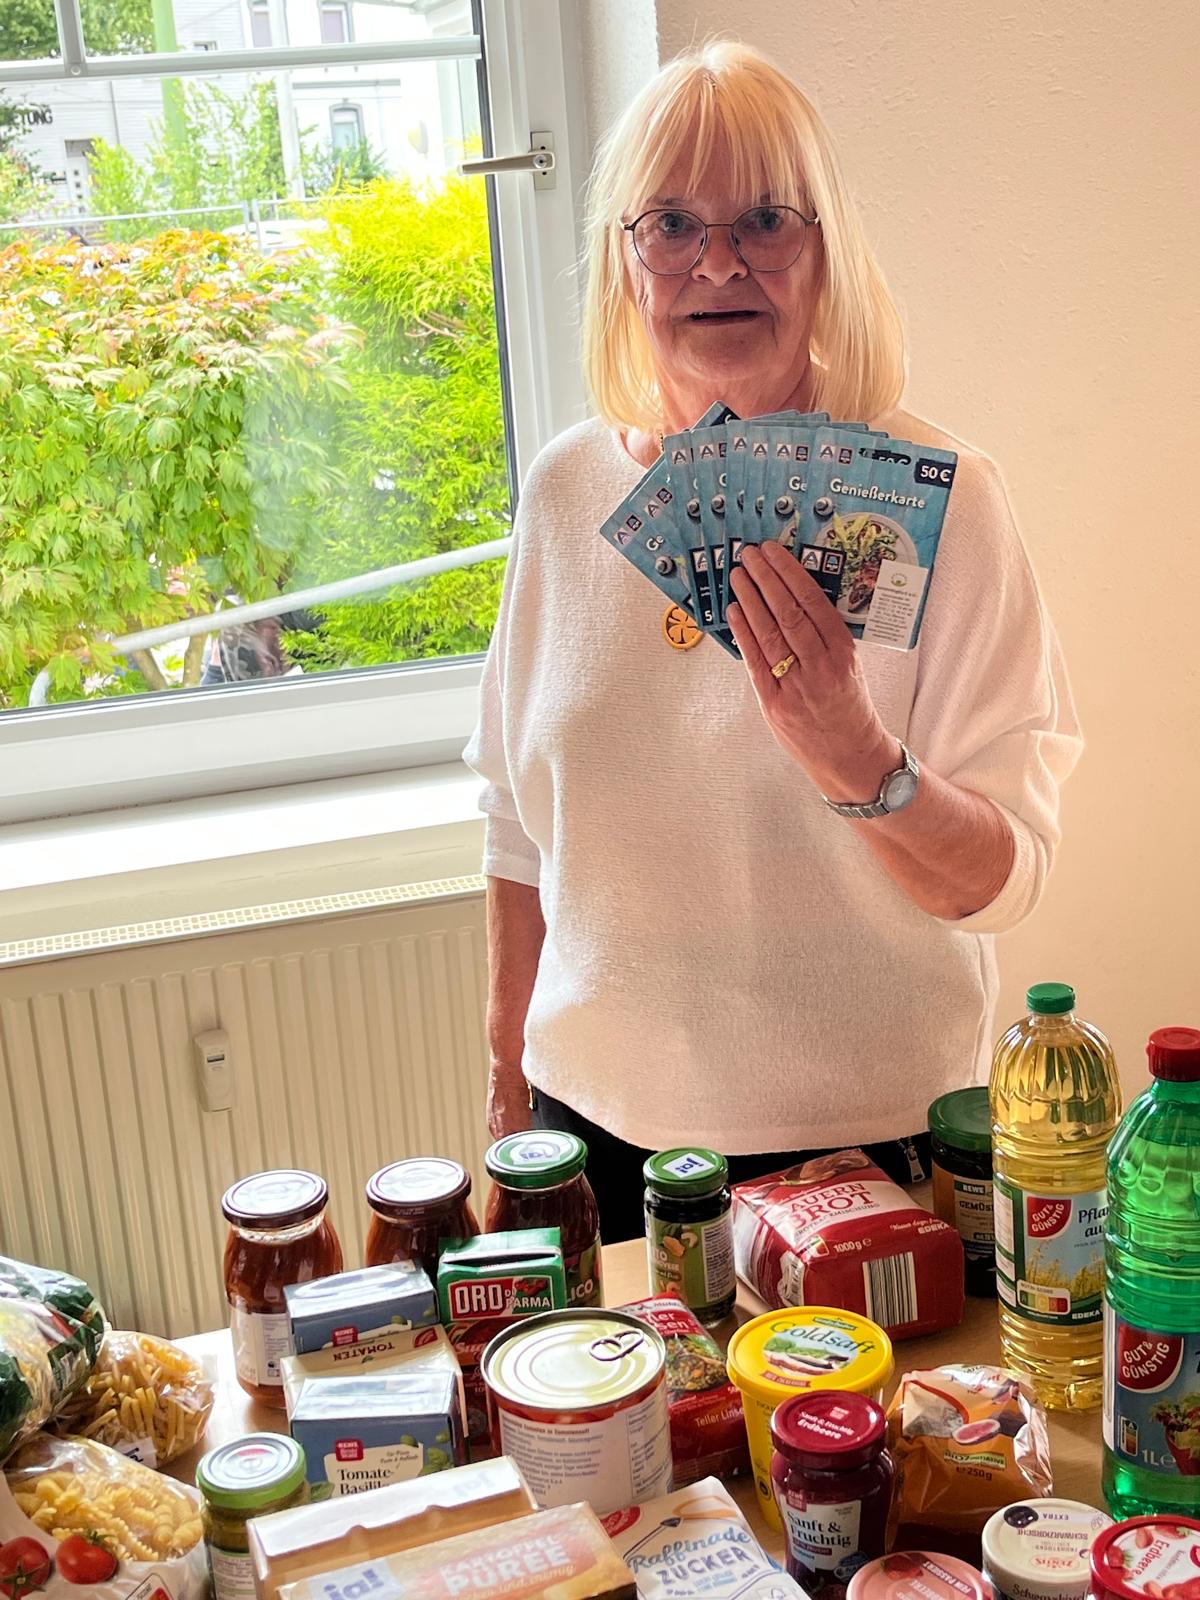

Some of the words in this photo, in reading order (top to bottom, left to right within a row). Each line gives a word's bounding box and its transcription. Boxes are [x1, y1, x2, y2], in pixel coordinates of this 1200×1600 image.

[920, 465, 938, 480] 50
[939, 469, 952, 483] €
[830, 478, 926, 509] Genießerkarte
[791, 1182, 867, 1213] AUERN
[962, 1184, 985, 1194] REWE
[789, 1191, 873, 1228] BROT
[1031, 1203, 1065, 1232] GÜNSTIG
[917, 1222, 950, 1234] EDEKA
[1085, 1224, 1105, 1238] au
[834, 1242, 855, 1253] 1000
[454, 1284, 503, 1314] ORO
[506, 1296, 551, 1309] PARMA
[567, 1278, 594, 1304] ICO
[1072, 1310, 1100, 1320] EDEKA
[770, 1320, 876, 1354] Goldsaft
[332, 1341, 396, 1362] TOMATEN
[1122, 1342, 1170, 1379] GÜNSTIG
[695, 1414, 720, 1428] Teller
[797, 1418, 842, 1439] Erdbeere
[337, 1468, 394, 1481] Tomate-
[967, 1466, 984, 1477] 250
[787, 1510, 824, 1532] Sanft
[828, 1521, 842, 1533] &
[790, 1525, 852, 1547] Fruchtig
[1017, 1528, 1088, 1541] SCHWARZKIRSCHE
[440, 1535, 563, 1578] KARTOFFEL
[627, 1527, 751, 1572] Raffinade
[1133, 1539, 1170, 1576] Erdbeere
[656, 1546, 754, 1585] ZUCKER
